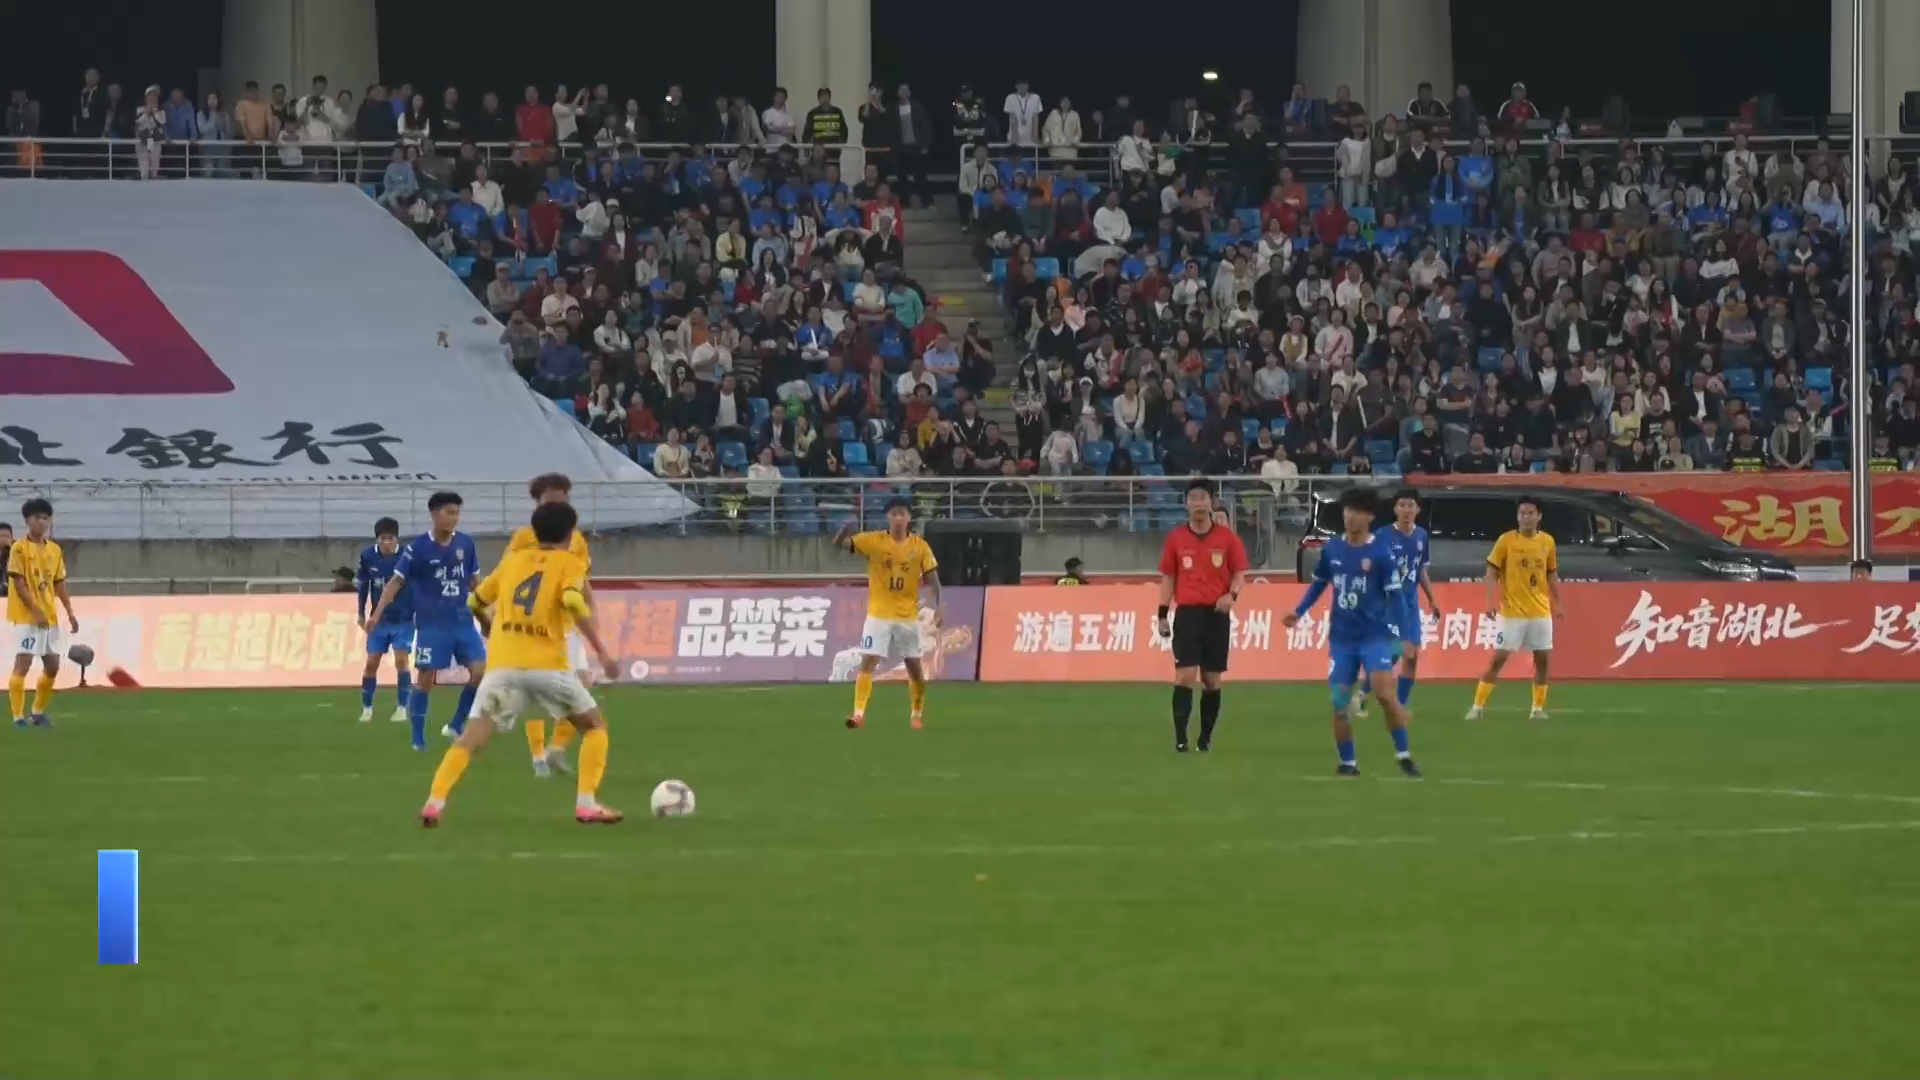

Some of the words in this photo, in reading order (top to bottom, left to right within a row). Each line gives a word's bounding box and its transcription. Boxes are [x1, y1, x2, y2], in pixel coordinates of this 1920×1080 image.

[441, 580, 460, 596] 25
[513, 571, 544, 616] 4
[889, 577, 904, 592] 10
[1338, 591, 1358, 610] 69
[677, 596, 832, 658] 品楚菜
[1013, 610, 1137, 652] 游遍五洲
[1496, 631, 1504, 645] 6
[1609, 590, 1852, 669] 知音湖北
